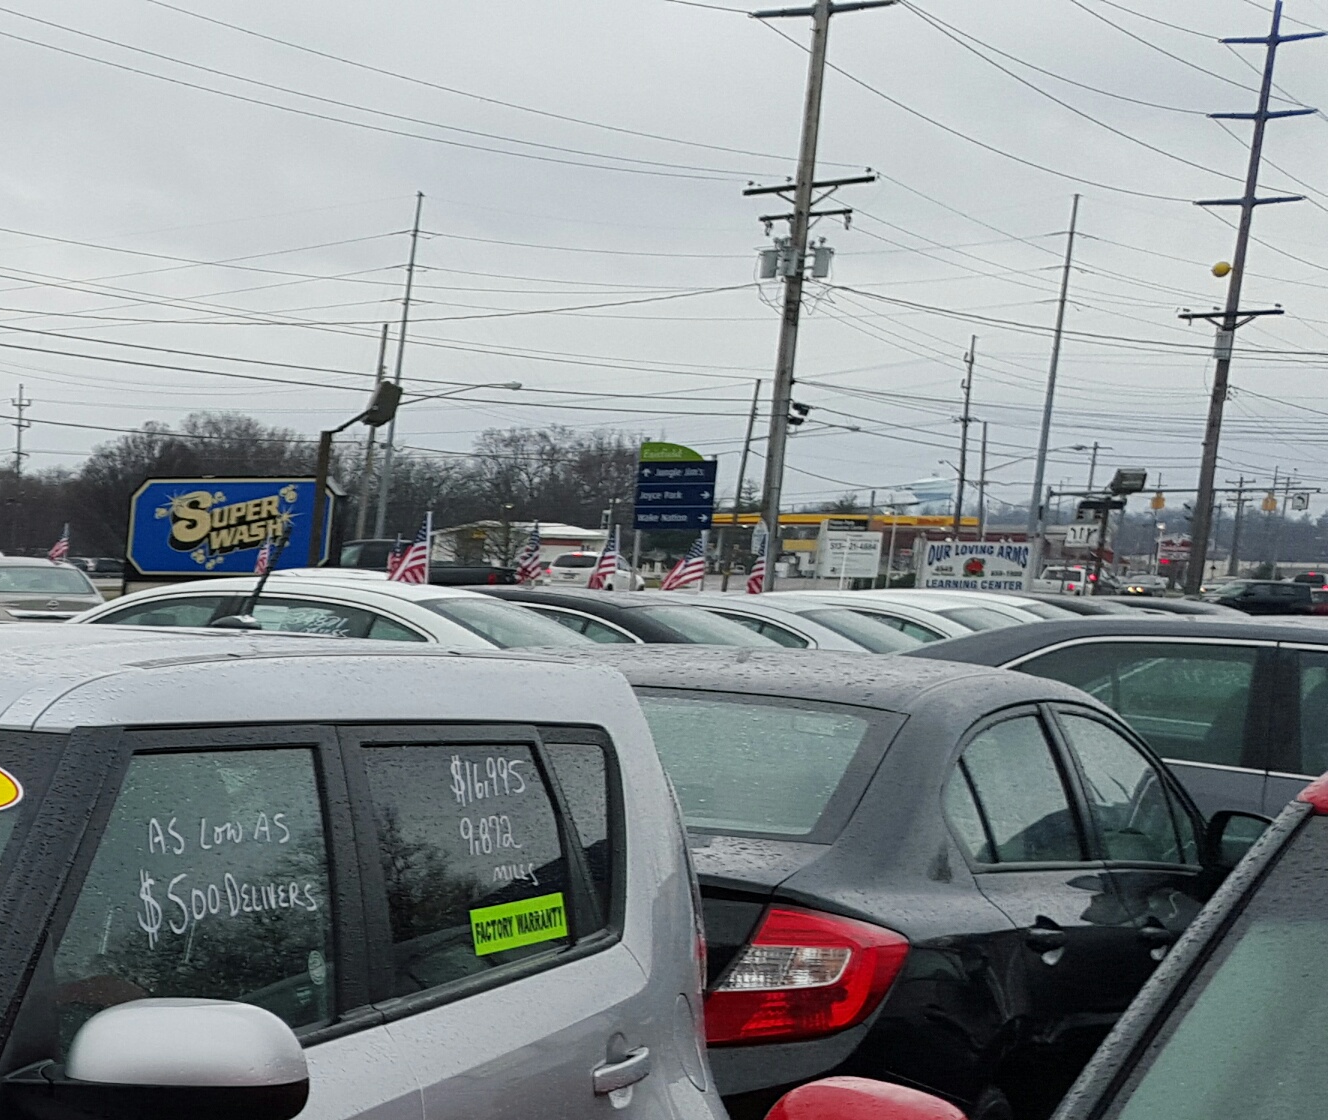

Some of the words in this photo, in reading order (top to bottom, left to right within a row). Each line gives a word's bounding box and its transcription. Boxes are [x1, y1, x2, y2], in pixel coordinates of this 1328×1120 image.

[655, 468, 682, 479] Jungle
[639, 491, 663, 502] Joyce
[664, 491, 683, 500] Park
[170, 490, 281, 544] SUPER
[637, 513, 660, 522] Wake
[661, 513, 688, 522] Nation
[208, 516, 284, 550] WASH
[927, 544, 953, 567] OUR
[955, 544, 995, 557] LOVING
[997, 544, 1030, 569] ARMS
[925, 579, 978, 590] LEARNING
[980, 580, 1023, 591] CENTER
[148, 816, 185, 855] AS
[200, 817, 244, 850] LOW
[253, 812, 291, 844] AS
[492, 862, 540, 887] MILES
[136, 868, 221, 951] $500
[223, 872, 318, 917] DELIVERS
[474, 914, 515, 945] FACTORY
[515, 905, 564, 936] WARRANTY
